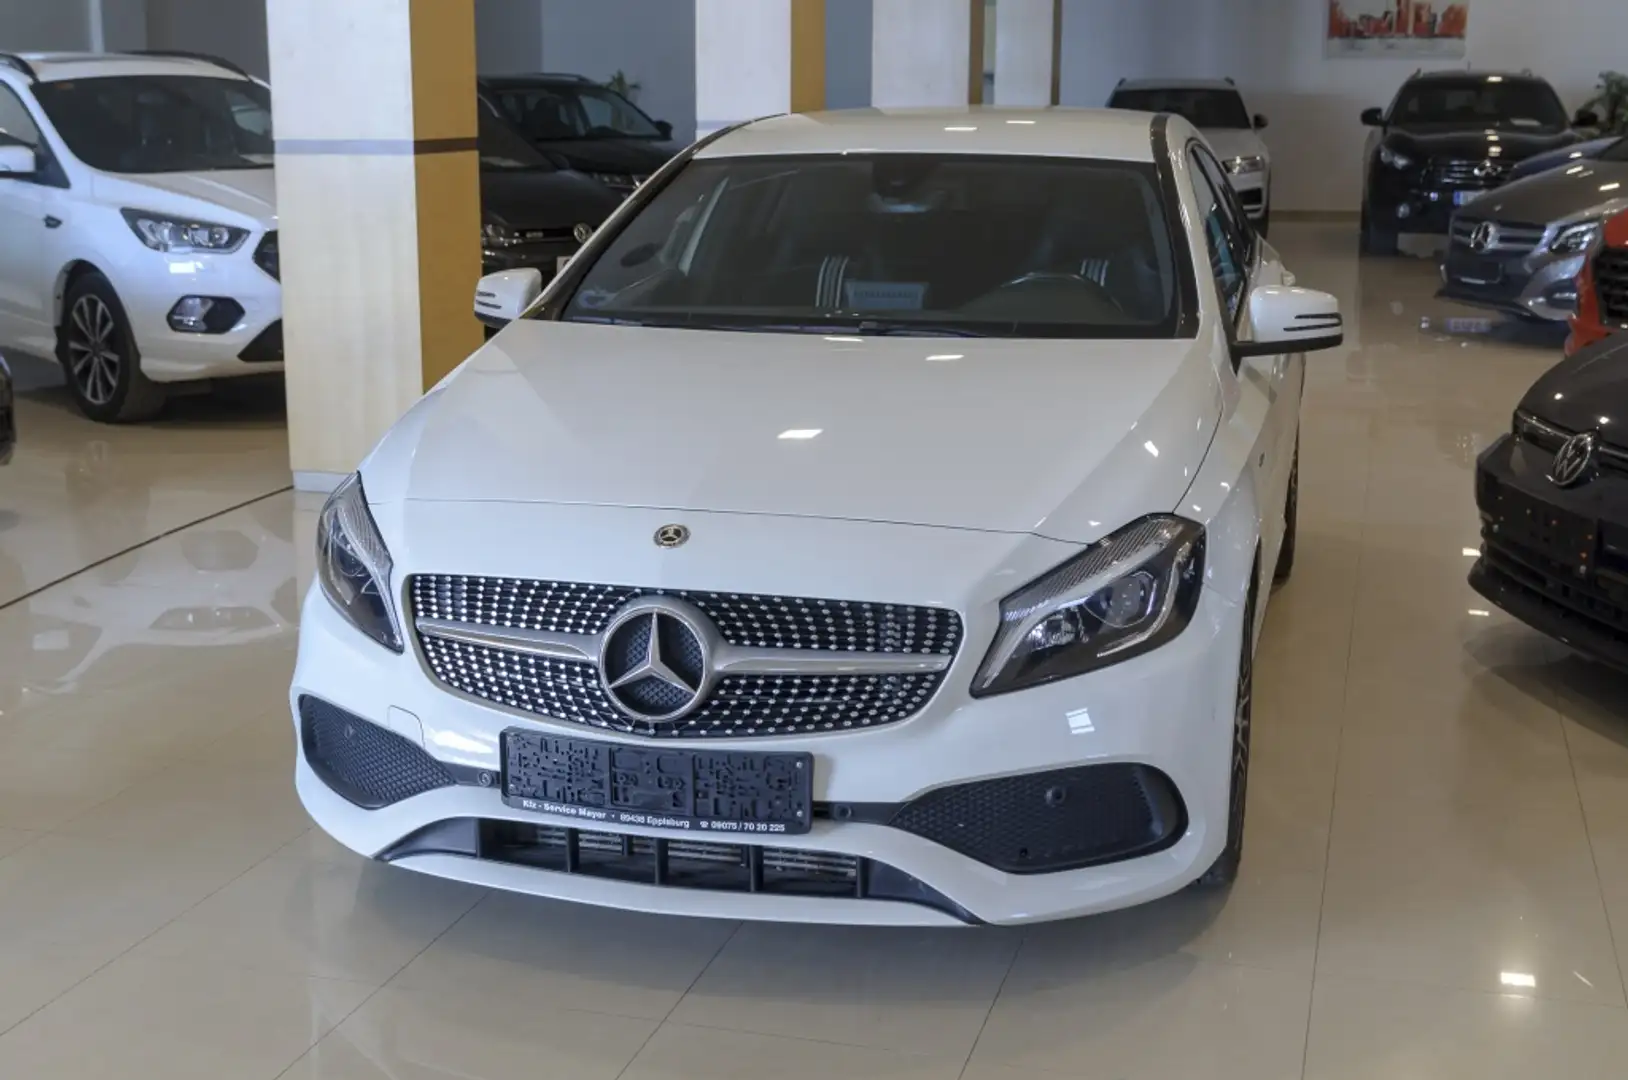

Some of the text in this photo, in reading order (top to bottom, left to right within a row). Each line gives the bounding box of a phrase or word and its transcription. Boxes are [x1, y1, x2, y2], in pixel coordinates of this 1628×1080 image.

[544, 803, 577, 815] Service
[578, 807, 607, 819] Mayer
[743, 822, 755, 831] 70
[756, 822, 768, 832] 20
[768, 823, 785, 832] 225
